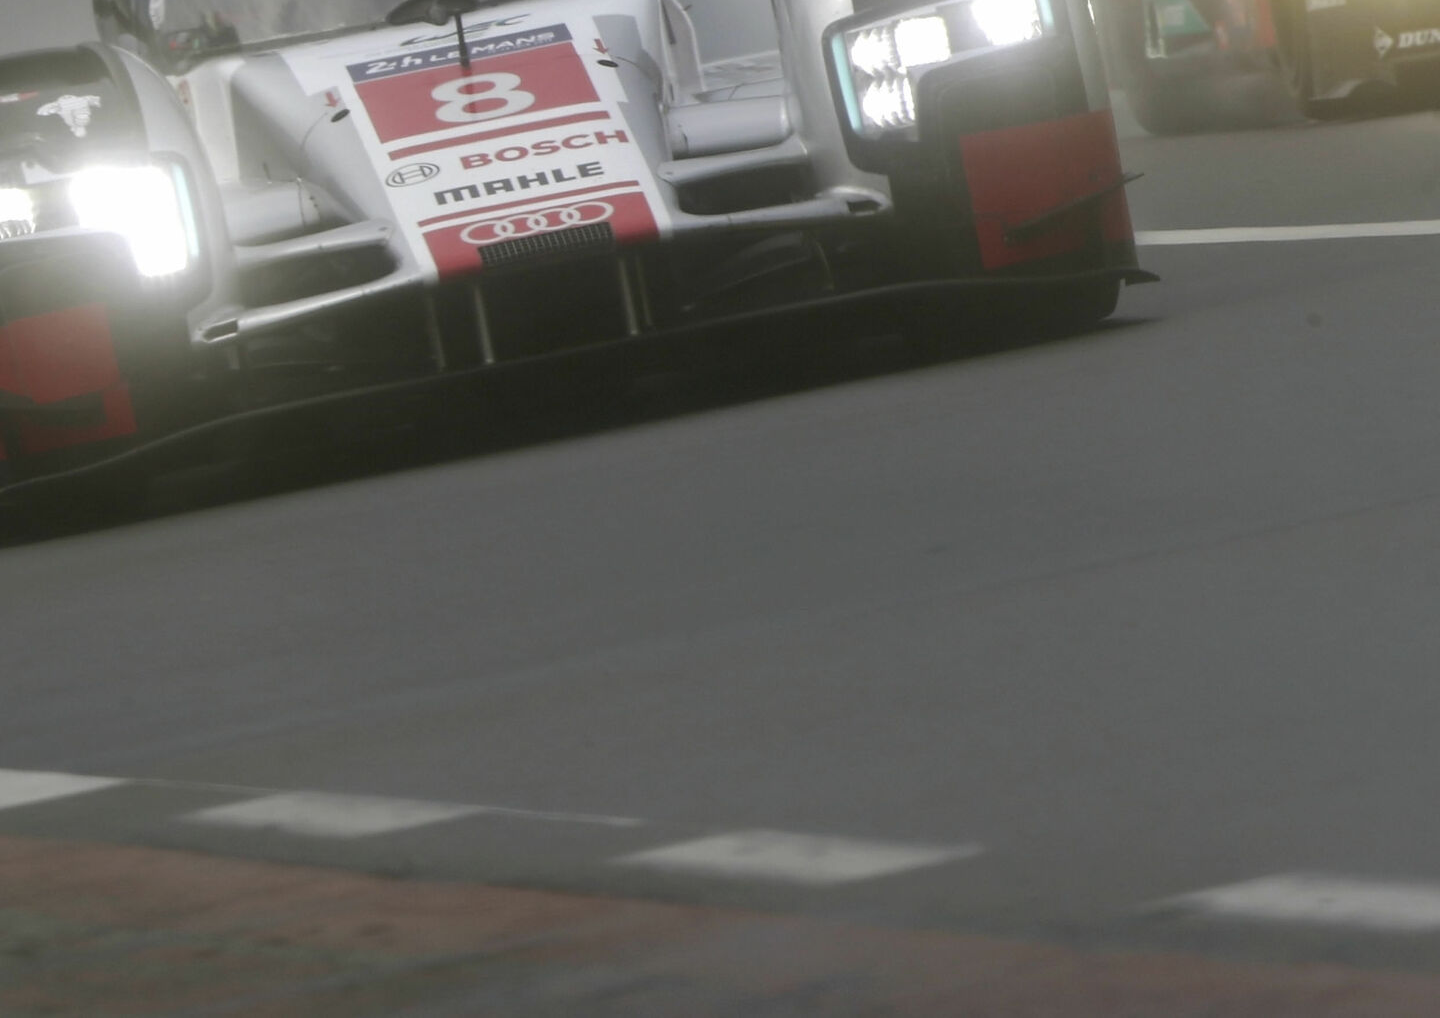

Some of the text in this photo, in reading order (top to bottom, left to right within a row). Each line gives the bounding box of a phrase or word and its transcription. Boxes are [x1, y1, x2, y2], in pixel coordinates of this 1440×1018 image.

[471, 31, 555, 55] MANS
[431, 72, 536, 122] 8
[460, 129, 630, 171] BOSCH
[433, 161, 606, 206] MAHLE
